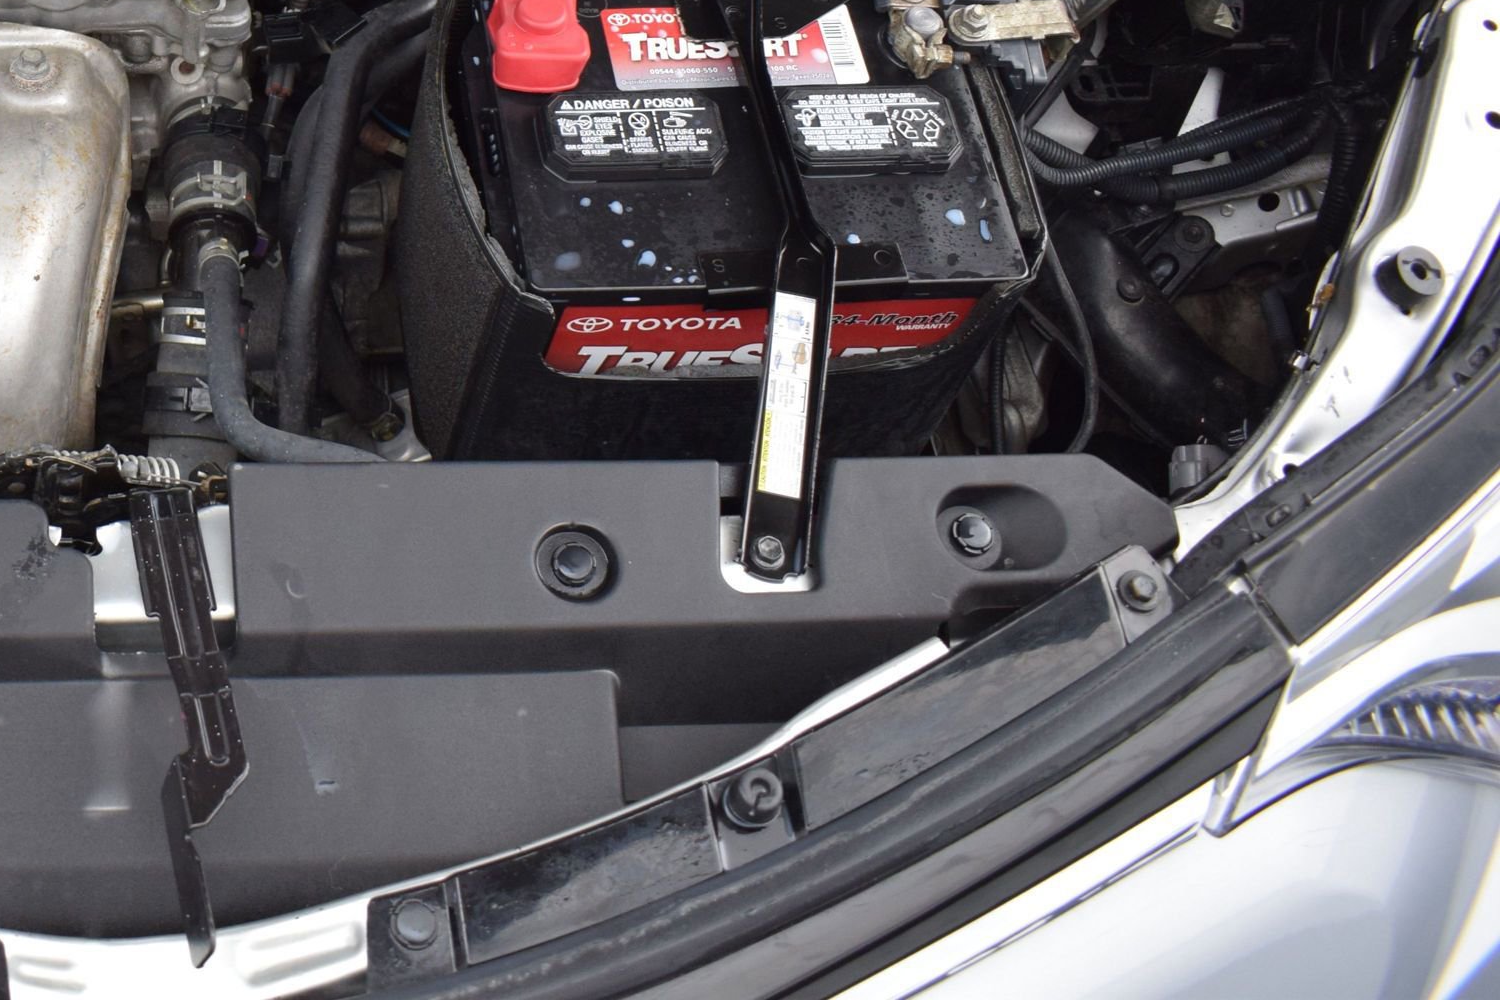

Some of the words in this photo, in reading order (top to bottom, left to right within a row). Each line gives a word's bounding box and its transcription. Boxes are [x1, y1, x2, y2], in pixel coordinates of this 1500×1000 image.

[632, 14, 677, 23] TOYO
[621, 32, 802, 61] TRUESRT
[574, 99, 630, 109] DANGER
[632, 99, 640, 109] /
[643, 97, 694, 108] POISON
[620, 317, 742, 331] TOYOTA
[895, 323, 951, 331] WARRANTY
